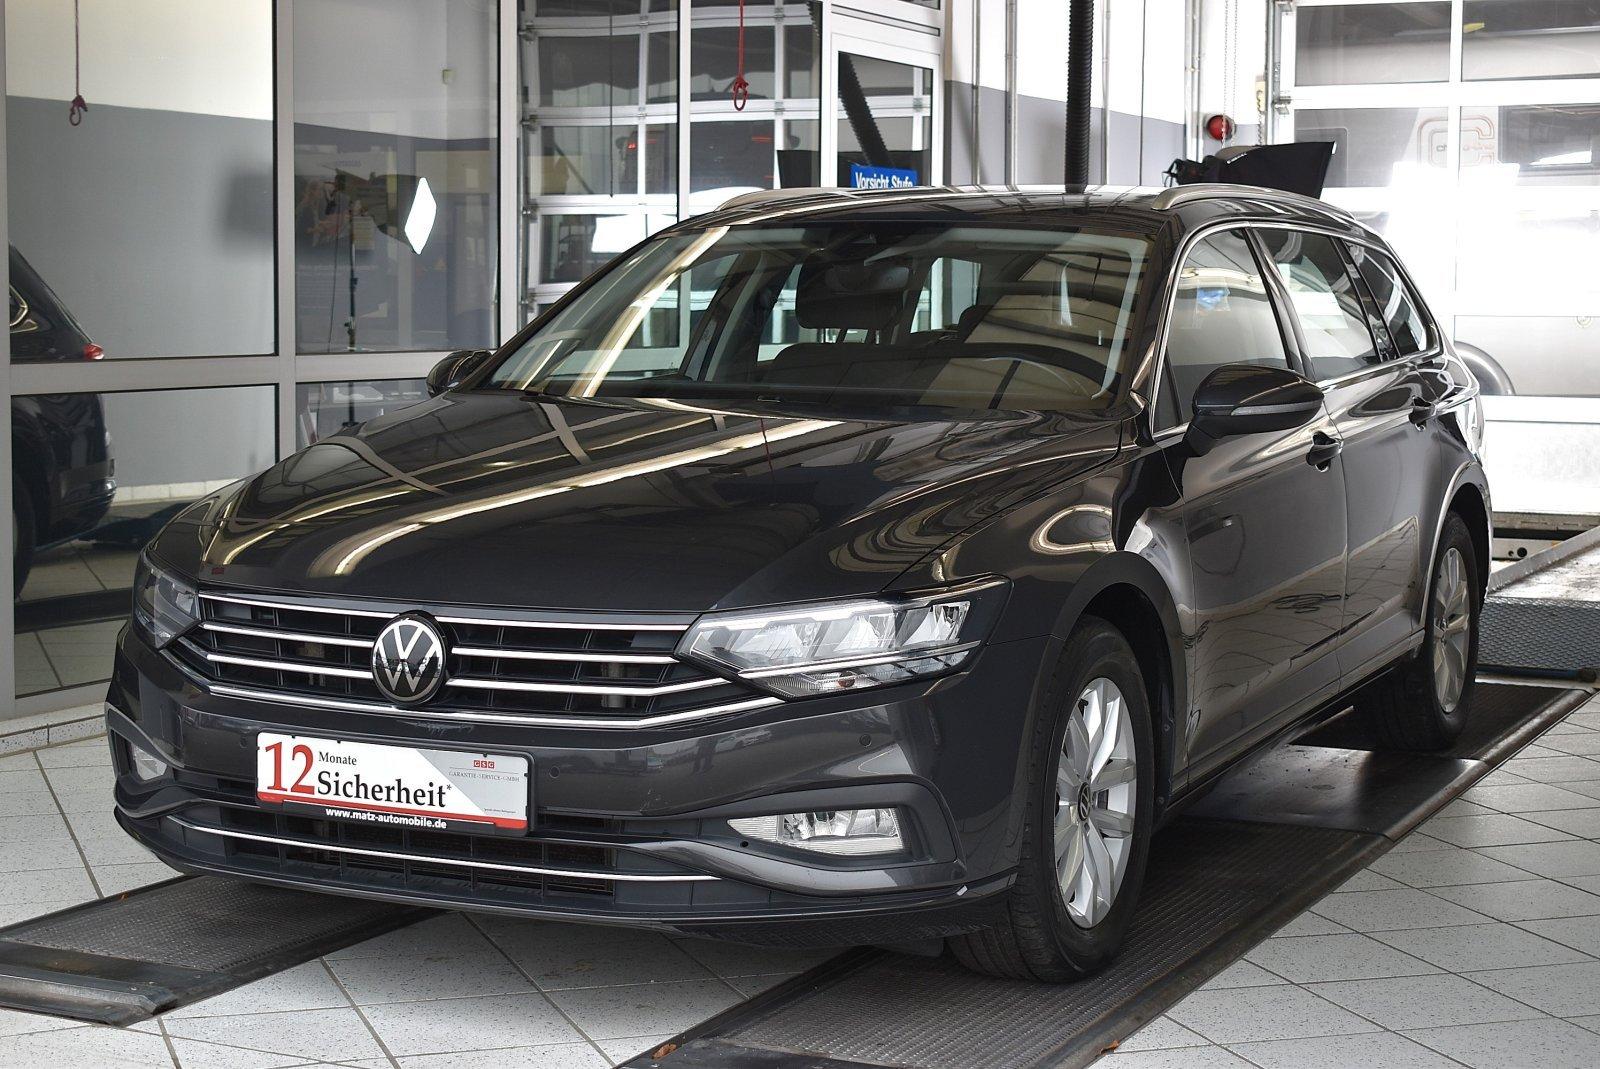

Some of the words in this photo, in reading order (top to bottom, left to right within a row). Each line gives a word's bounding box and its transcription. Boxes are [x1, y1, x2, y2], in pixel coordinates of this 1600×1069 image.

[855, 172, 889, 189] Vorsicht
[318, 751, 357, 766] Monate
[473, 760, 495, 769] GSG
[265, 741, 315, 795] 12
[325, 808, 447, 829] www.matz-automobile.de
